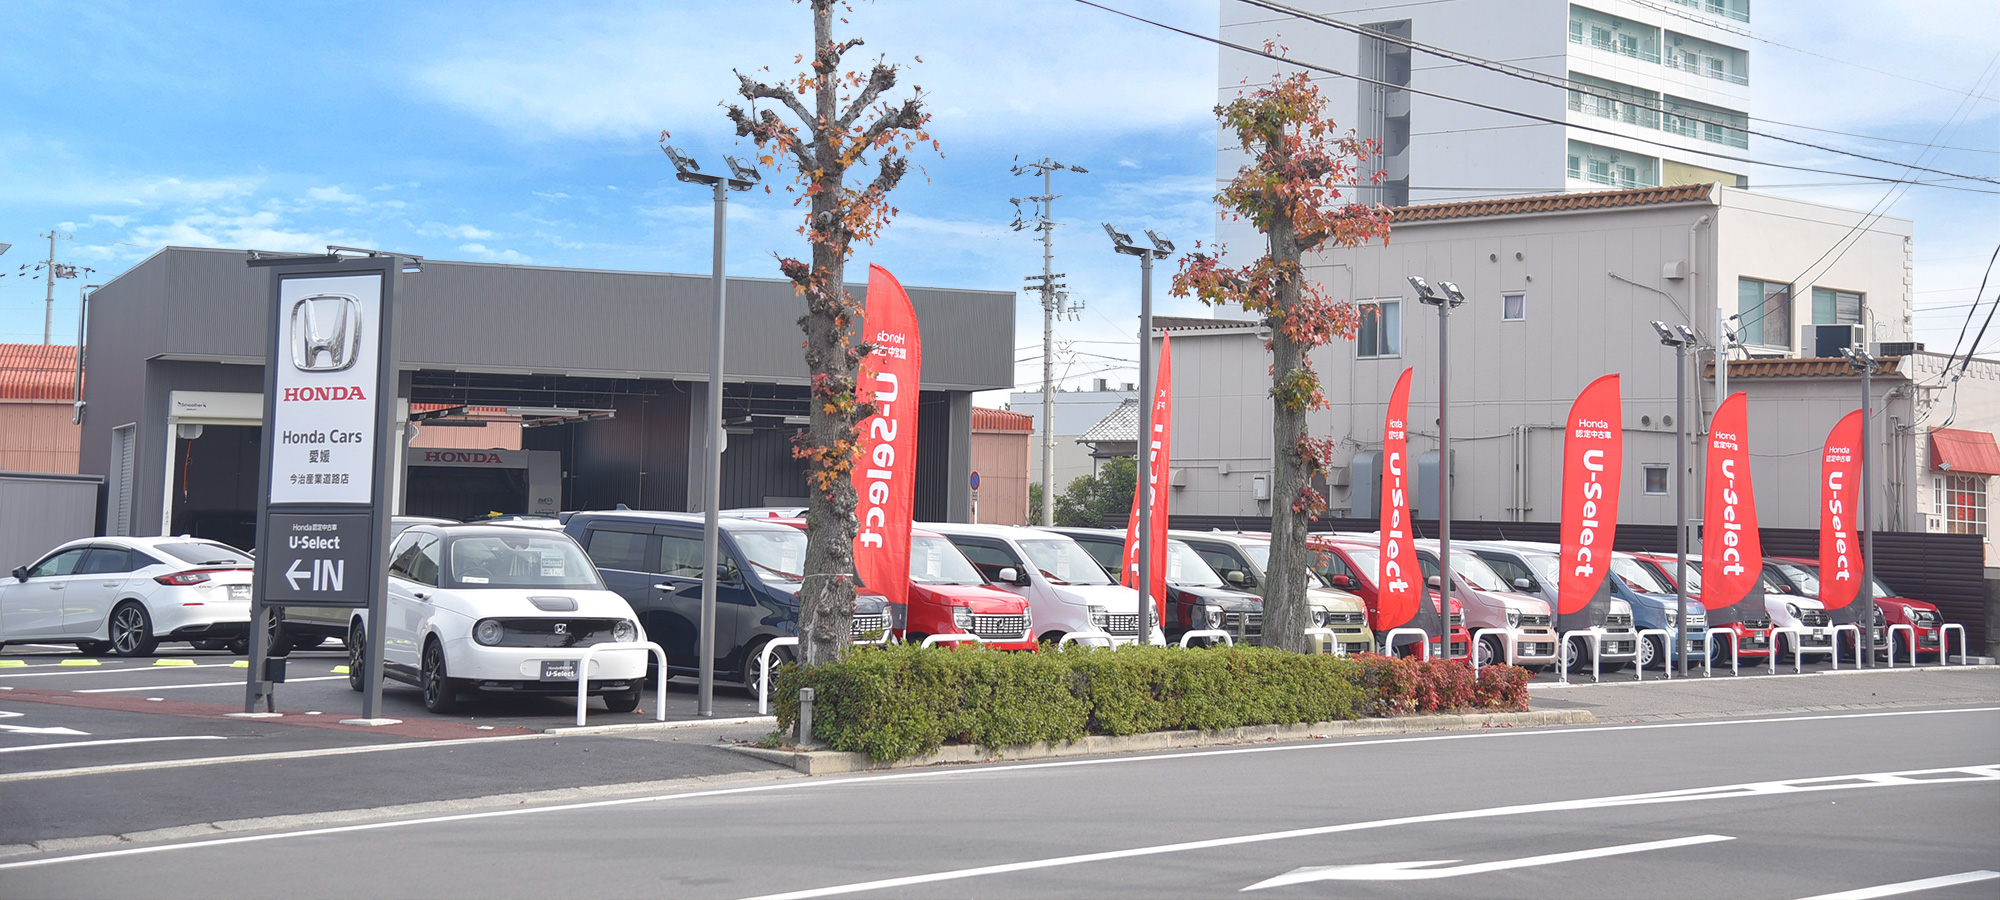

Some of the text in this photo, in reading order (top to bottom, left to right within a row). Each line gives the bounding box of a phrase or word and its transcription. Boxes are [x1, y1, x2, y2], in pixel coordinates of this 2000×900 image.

[283, 386, 367, 402] HONDA
[1578, 418, 1609, 429] Honda
[282, 429, 363, 444] Honda Cars
[1575, 429, 1612, 440] 認定中古車
[309, 449, 331, 464] 愛媛
[1828, 445, 1850, 454] Honda
[424, 451, 503, 464] HONDA
[290, 473, 350, 485] 今治産業道路店
[1574, 449, 1604, 578] U-Select
[1721, 459, 1745, 576] U-Select
[1385, 452, 1409, 593] U-Select
[1828, 471, 1851, 581] U-Select
[289, 535, 341, 549] U-Select
[313, 559, 344, 591] IN
